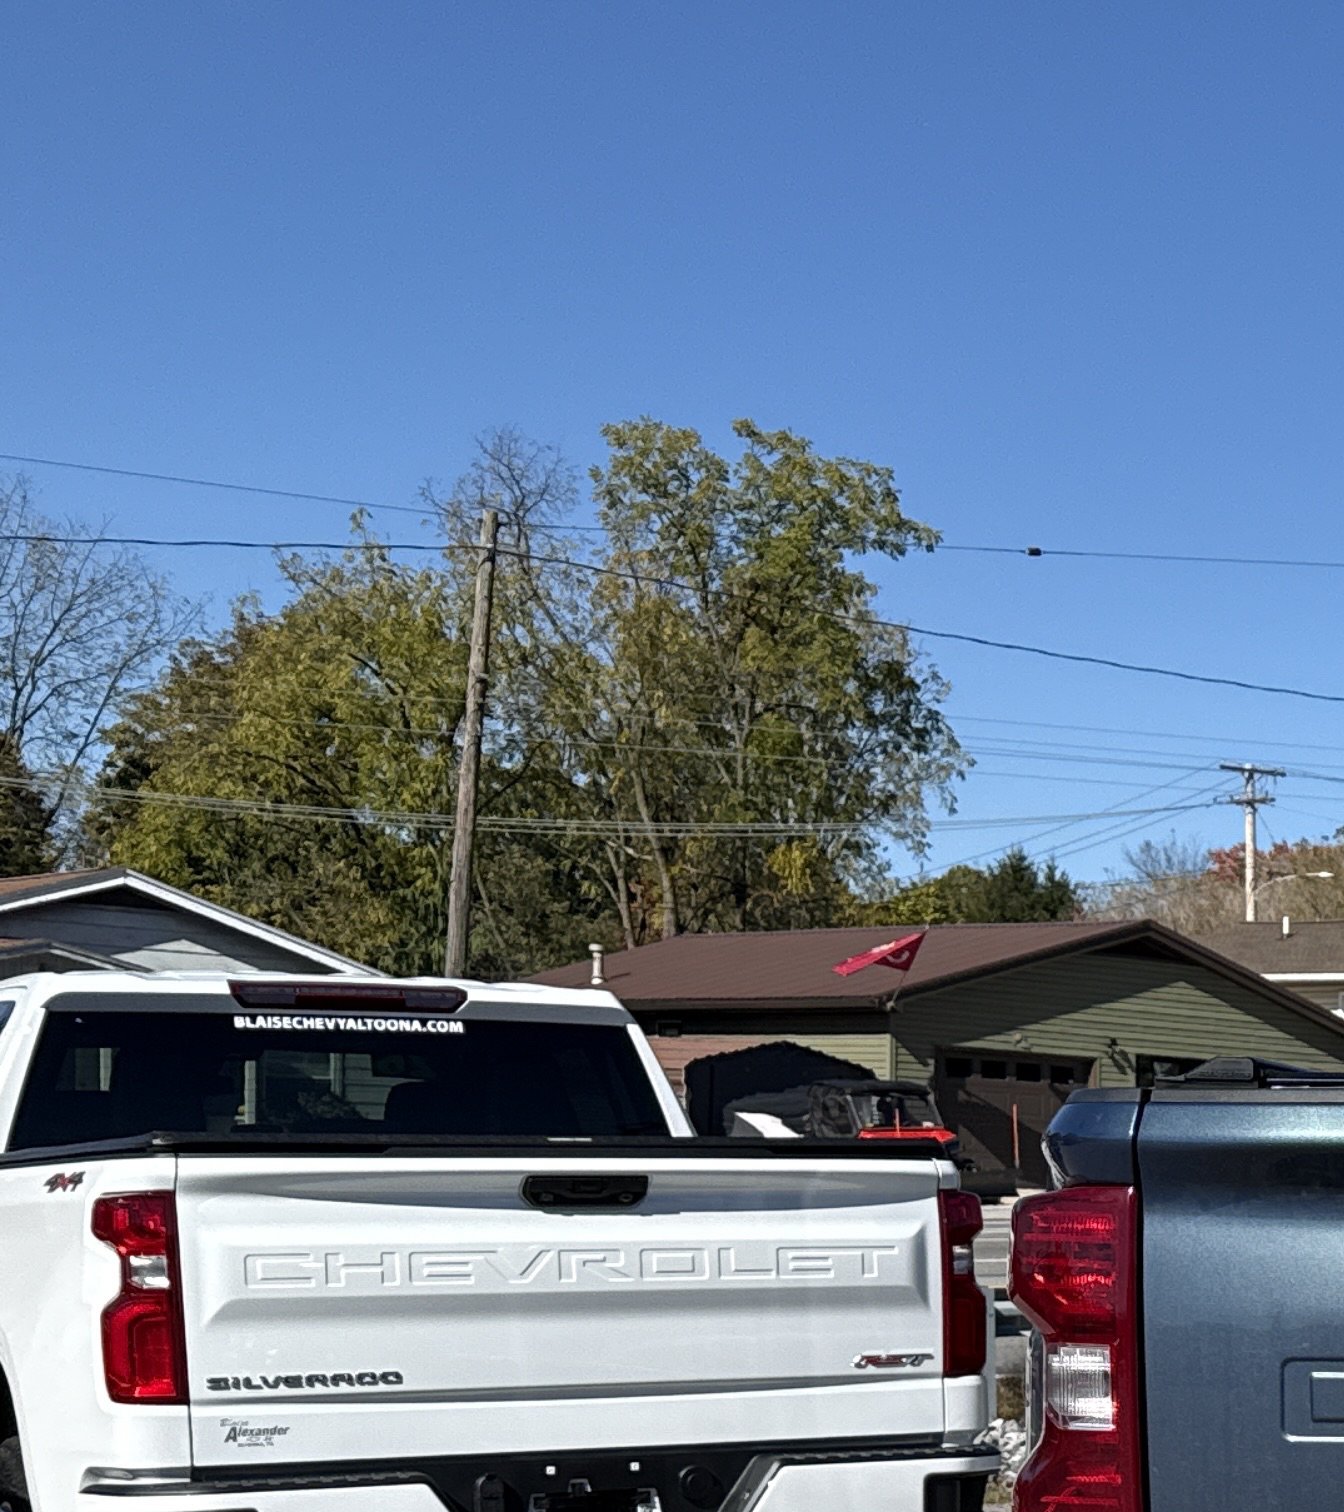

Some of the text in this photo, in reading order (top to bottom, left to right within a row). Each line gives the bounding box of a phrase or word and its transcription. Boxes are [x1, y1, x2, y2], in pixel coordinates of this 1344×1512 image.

[234, 1015, 464, 1033] BLAISECHEVYALTOONA.COM
[243, 1245, 899, 1289] CHEVROLET
[206, 1371, 403, 1391] SILVERADO
[224, 1426, 290, 1443] Alexander
